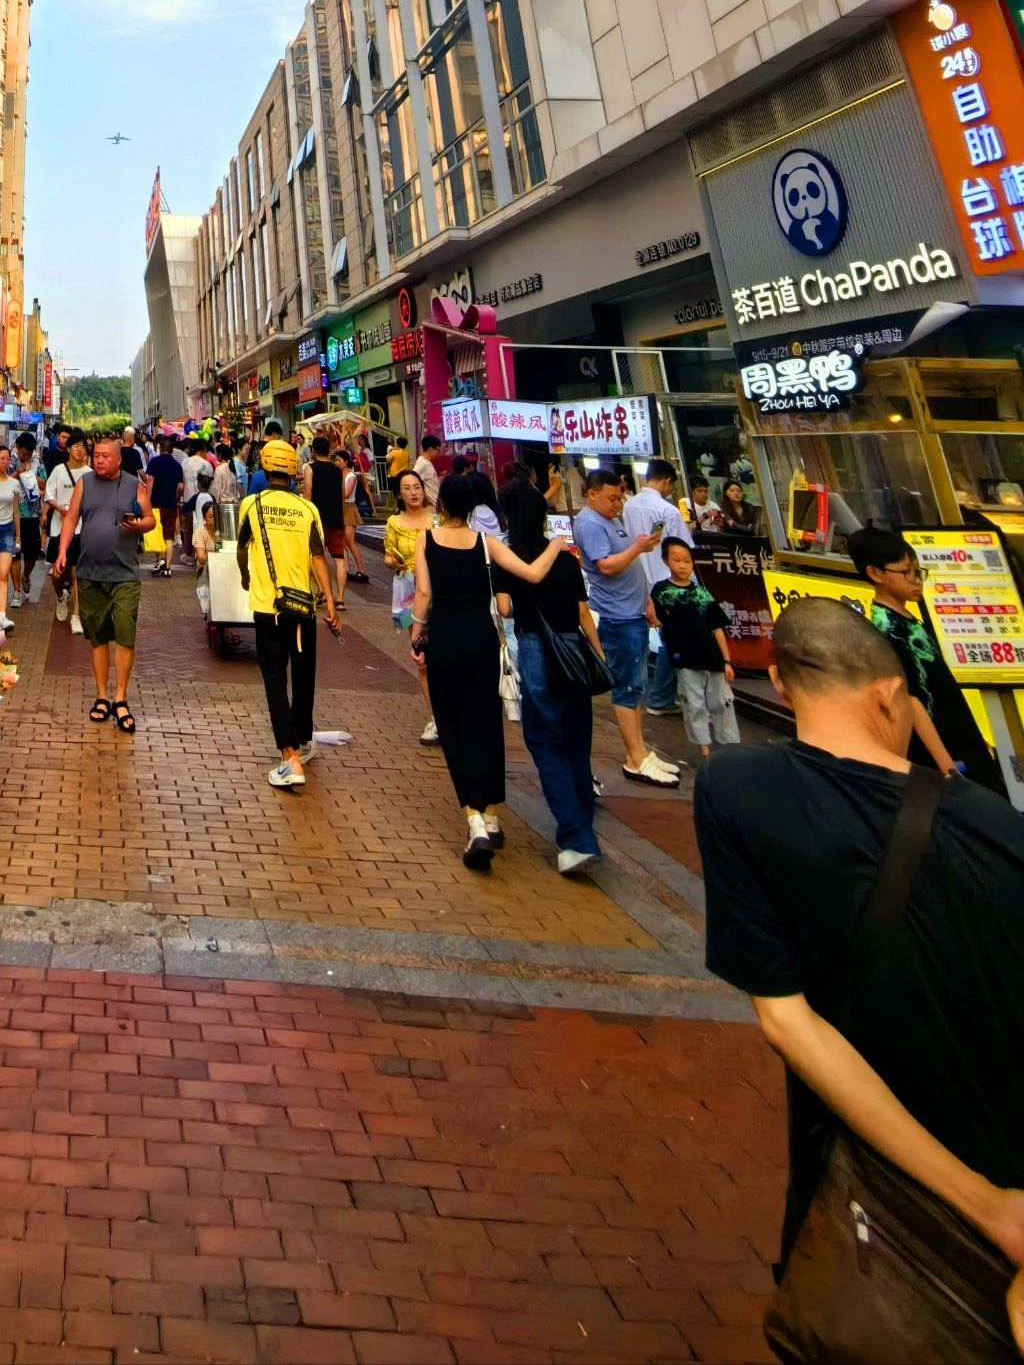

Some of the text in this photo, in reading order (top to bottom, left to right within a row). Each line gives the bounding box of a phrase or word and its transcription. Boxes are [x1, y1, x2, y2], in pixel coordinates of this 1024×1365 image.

[940, 50, 966, 80] 24
[952, 83, 1004, 167] 自助
[961, 177, 1014, 261] 台球
[732, 242, 956, 325] 茶百道 ChaPanda
[673, 301, 709, 323] colorful
[741, 350, 857, 400] 周黑鸭
[444, 405, 481, 435] 酸辣凤爪
[758, 393, 840, 412] ZHOU HEI YA
[490, 412, 547, 432] 酸辣凤
[564, 402, 630, 445] 乐山炸串
